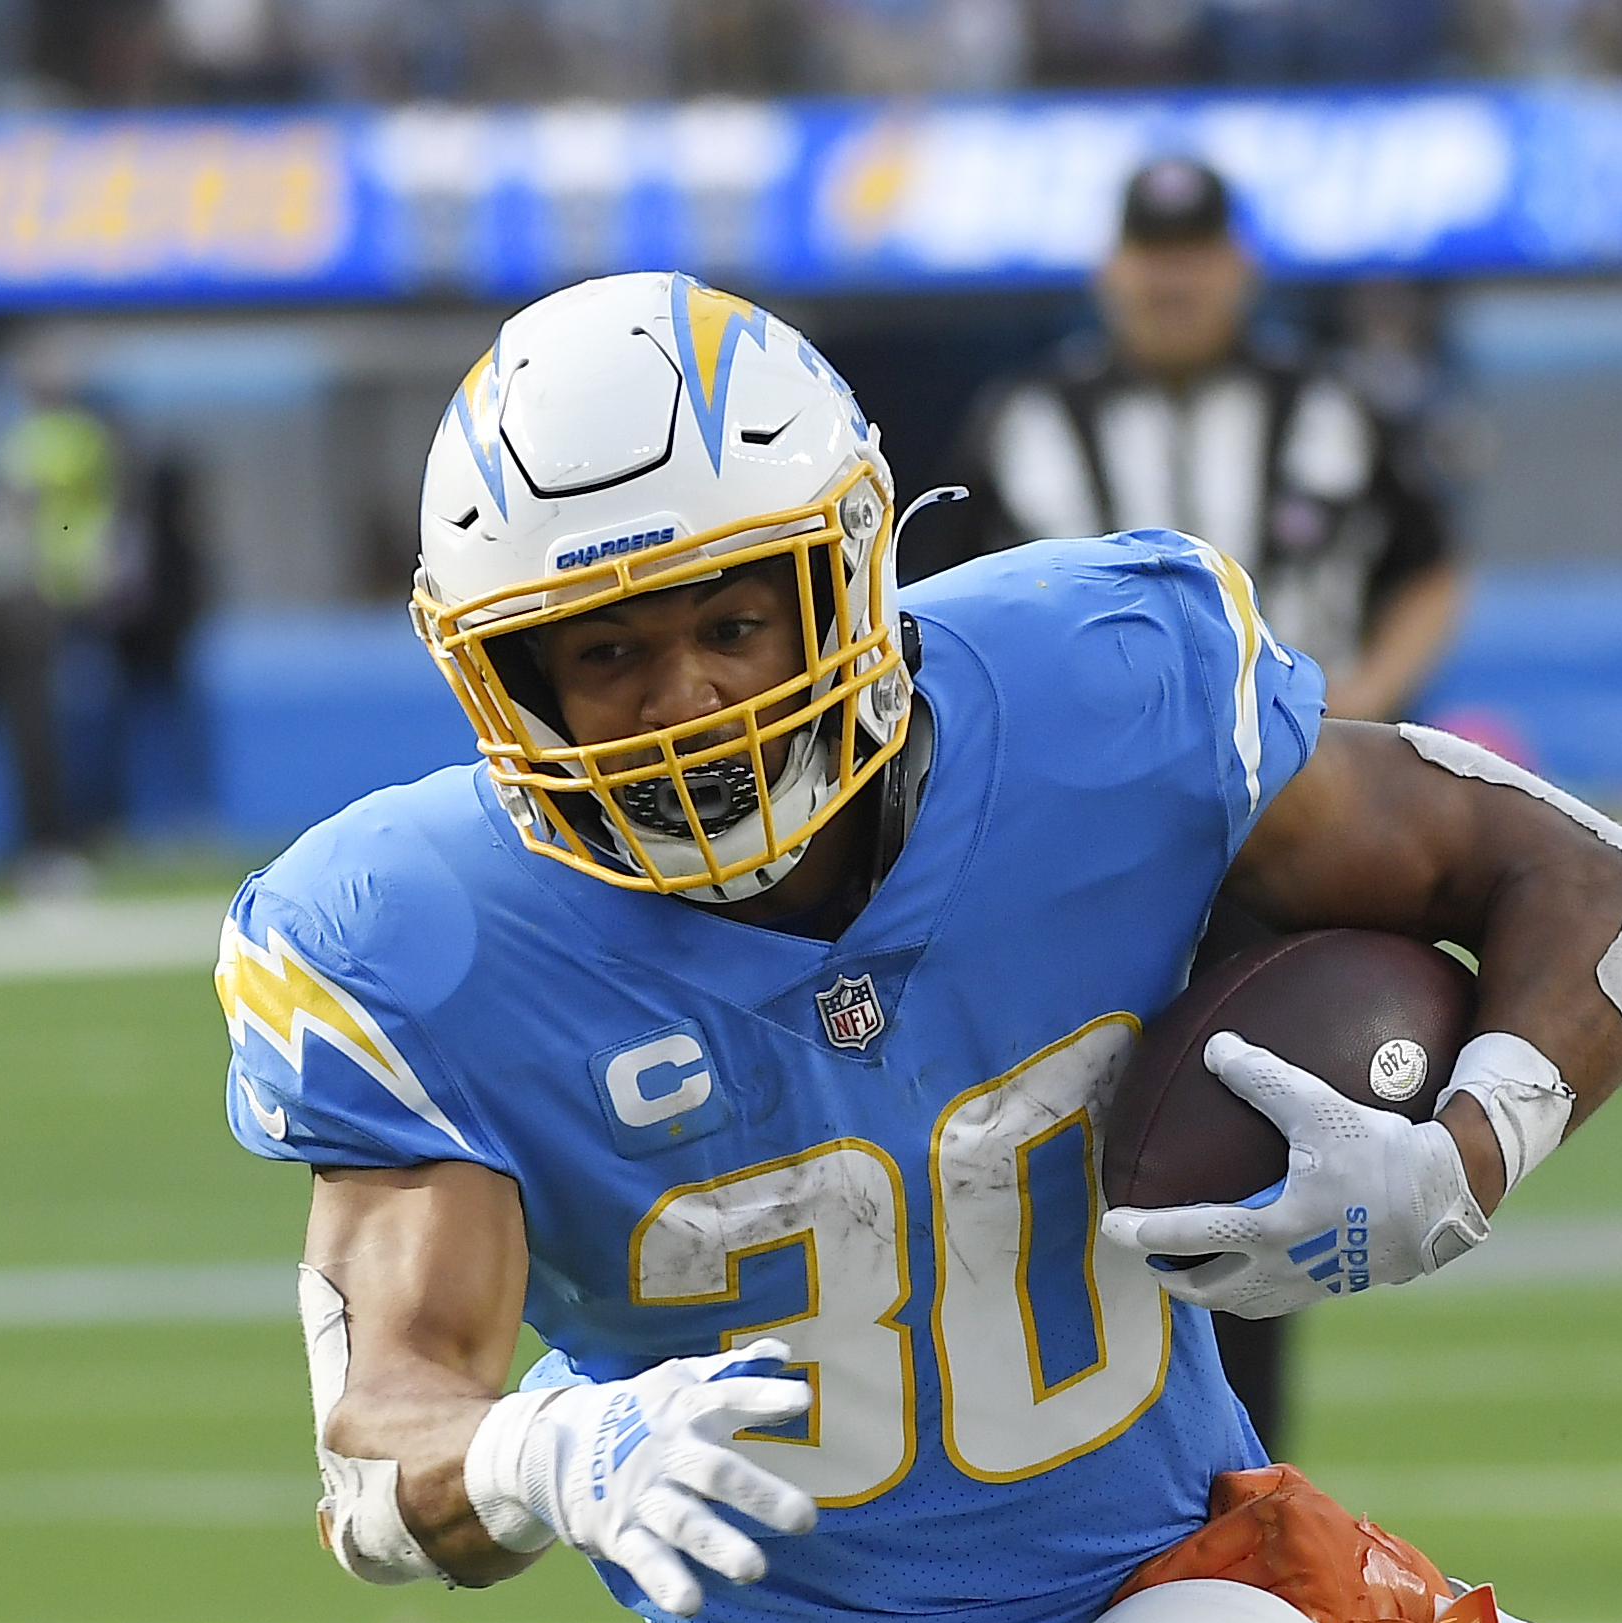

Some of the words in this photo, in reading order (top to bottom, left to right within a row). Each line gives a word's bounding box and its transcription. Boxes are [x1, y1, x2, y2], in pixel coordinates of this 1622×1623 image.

[555, 526, 675, 571] CHARGERS
[832, 1004, 877, 1038] NFL
[1378, 1042, 1411, 1078] 249
[605, 1033, 712, 1128] C
[628, 1009, 1171, 1509] 30
[1340, 1205, 1370, 1293] adidas
[590, 1392, 629, 1502] adidas
